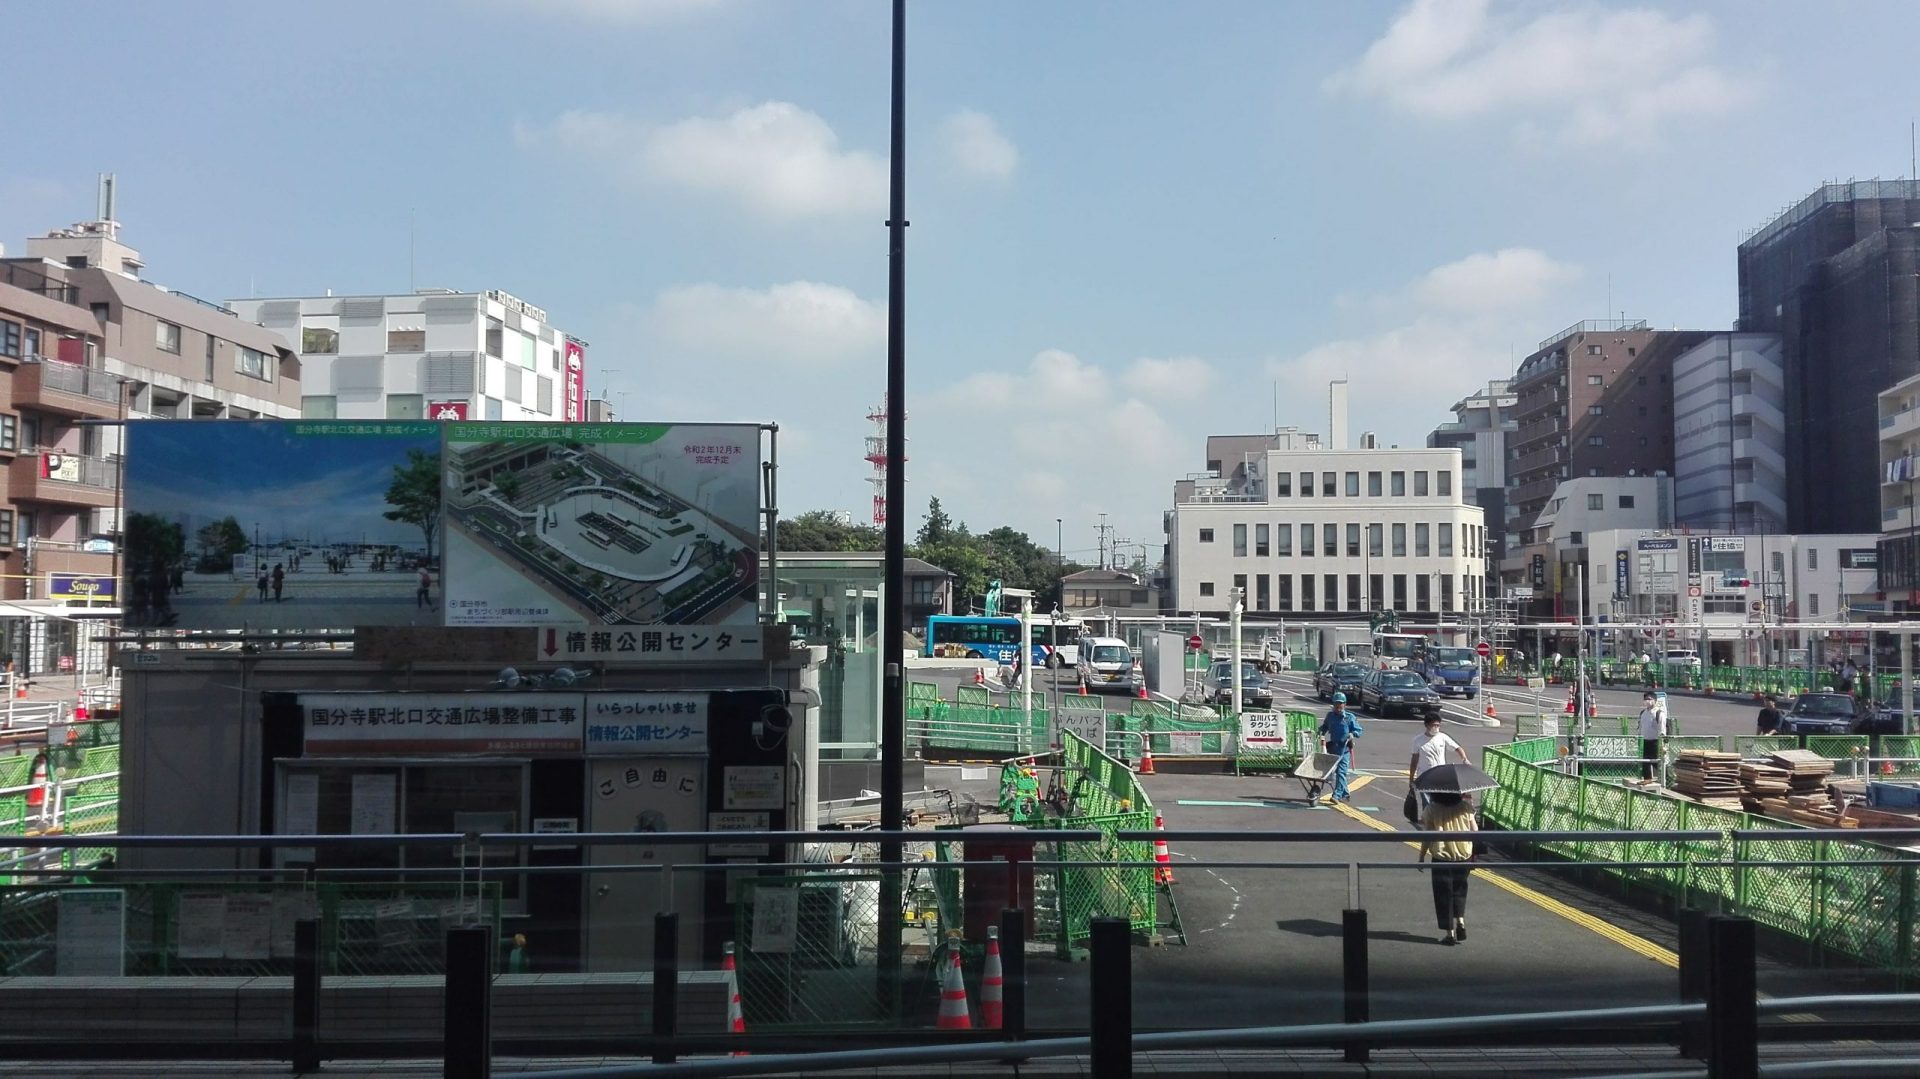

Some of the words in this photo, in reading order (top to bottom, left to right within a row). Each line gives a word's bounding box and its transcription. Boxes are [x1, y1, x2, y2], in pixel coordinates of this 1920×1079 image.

[296, 425, 381, 434] 国分寺駅北口交通広場
[385, 425, 437, 434] 完成イメージ
[455, 426, 573, 439] 国分寺駅北口交通広場
[578, 427, 649, 439] 完成イメージ
[684, 445, 742, 455] 令和2年12月末
[695, 455, 729, 464] 完成予定
[566, 631, 758, 652] 情報公開センター
[597, 702, 697, 715] いらっしゃいませ
[311, 707, 577, 726] 国分寺駅北口交通広場整備工事
[1250, 714, 1278, 722] 立川バス
[588, 725, 704, 742] 情報公開センター
